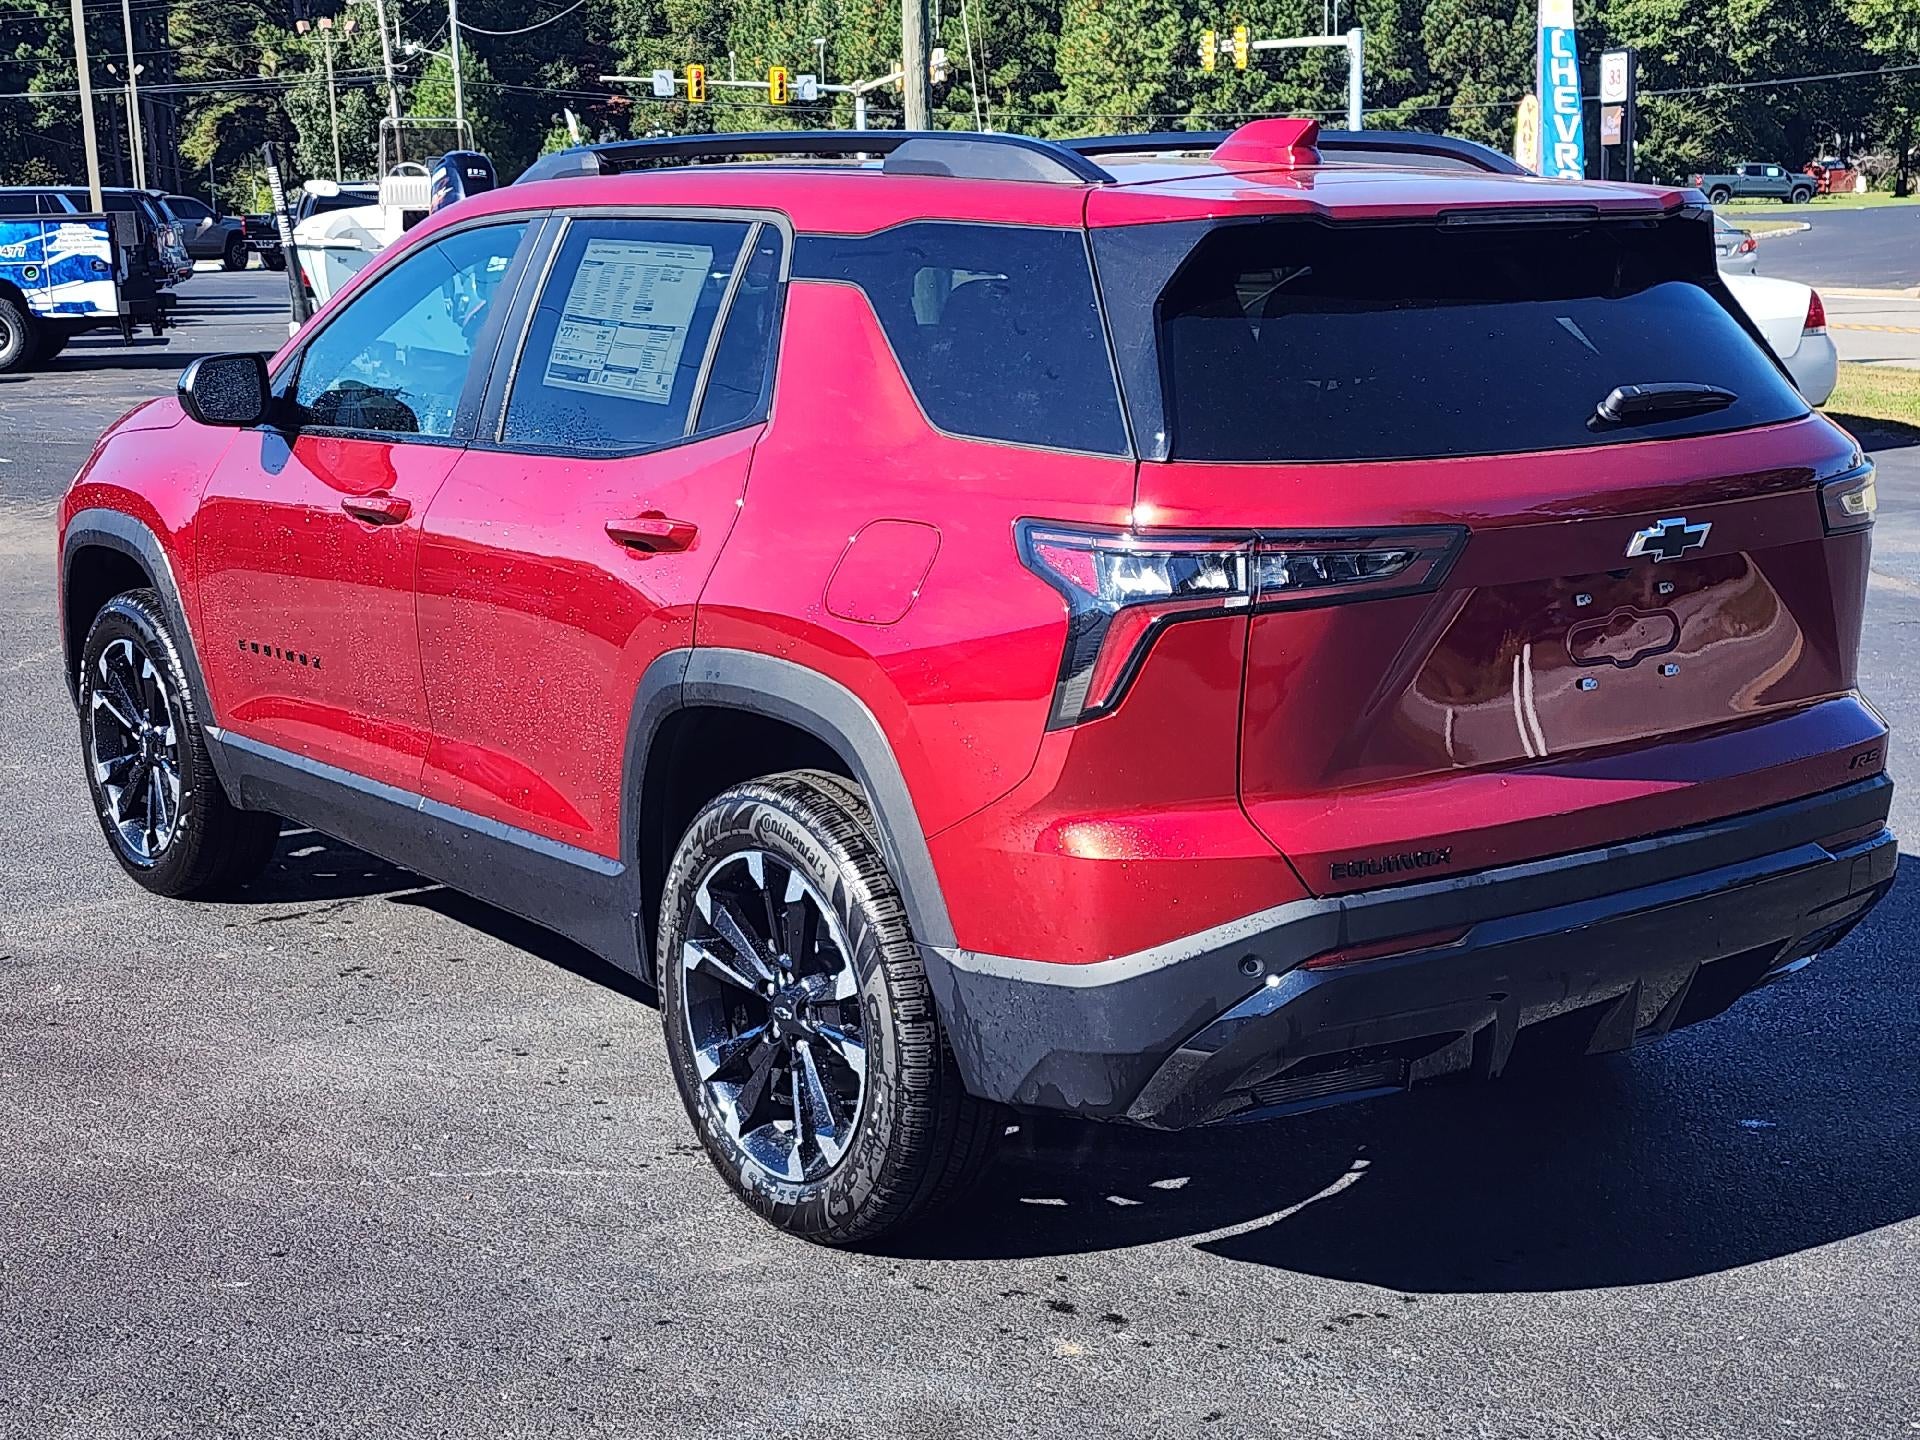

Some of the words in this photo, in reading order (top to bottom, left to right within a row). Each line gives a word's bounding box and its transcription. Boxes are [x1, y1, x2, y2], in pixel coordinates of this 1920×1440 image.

[267, 166, 287, 212] WHITMORE
[276, 215, 294, 248] MARINE
[1849, 748, 1880, 769] RS
[1329, 845, 1453, 880] EQUINOX
